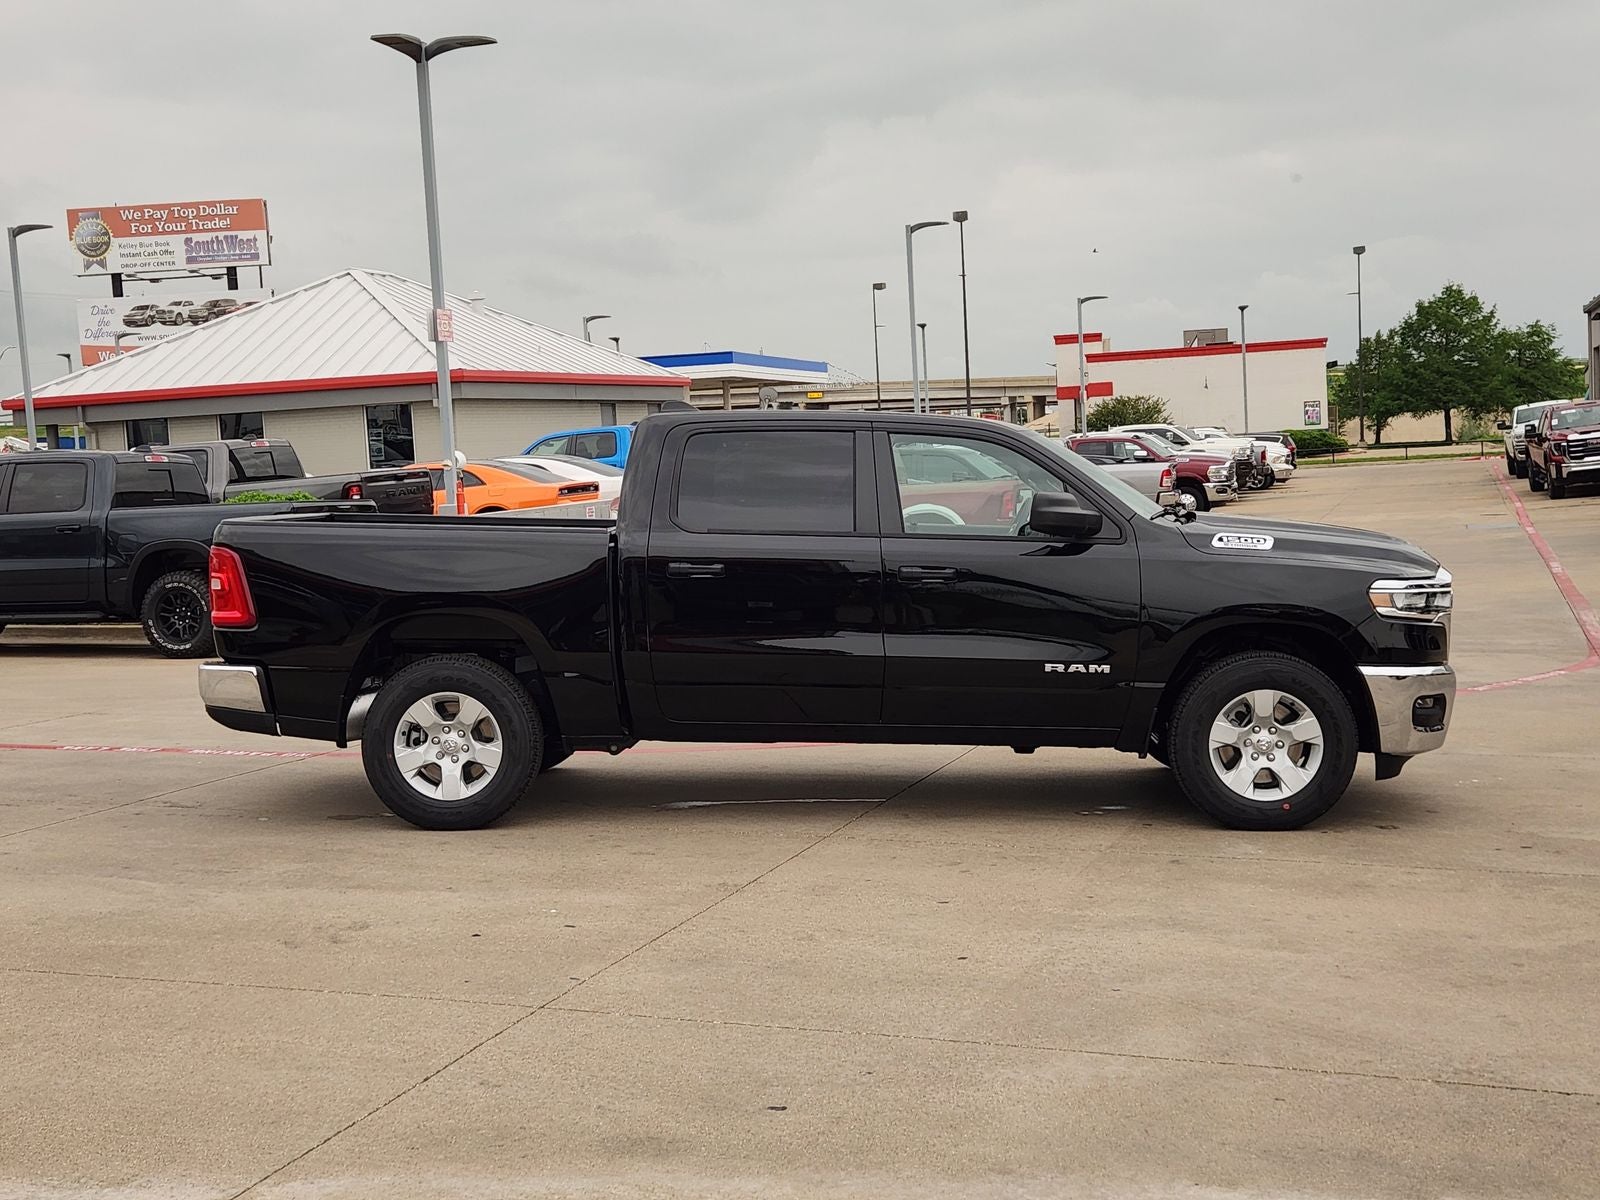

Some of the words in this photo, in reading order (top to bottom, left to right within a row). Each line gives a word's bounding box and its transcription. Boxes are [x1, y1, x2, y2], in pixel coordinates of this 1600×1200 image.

[120, 209, 141, 220] We
[144, 208, 168, 220] Pay
[171, 206, 196, 219] Top
[199, 203, 238, 216] Dollar
[130, 223, 153, 234] For
[155, 221, 187, 232] Your
[189, 218, 231, 230] Trade!
[118, 242, 137, 250] Kelley
[155, 240, 170, 248] Book
[184, 234, 259, 255] SouthWest
[143, 249, 158, 257] Cash
[90, 304, 115, 316] Drive
[97, 316, 111, 327] the
[385, 486, 416, 497] RAM
[1219, 536, 1266, 544] 1500
[1044, 663, 1111, 673] RAM
